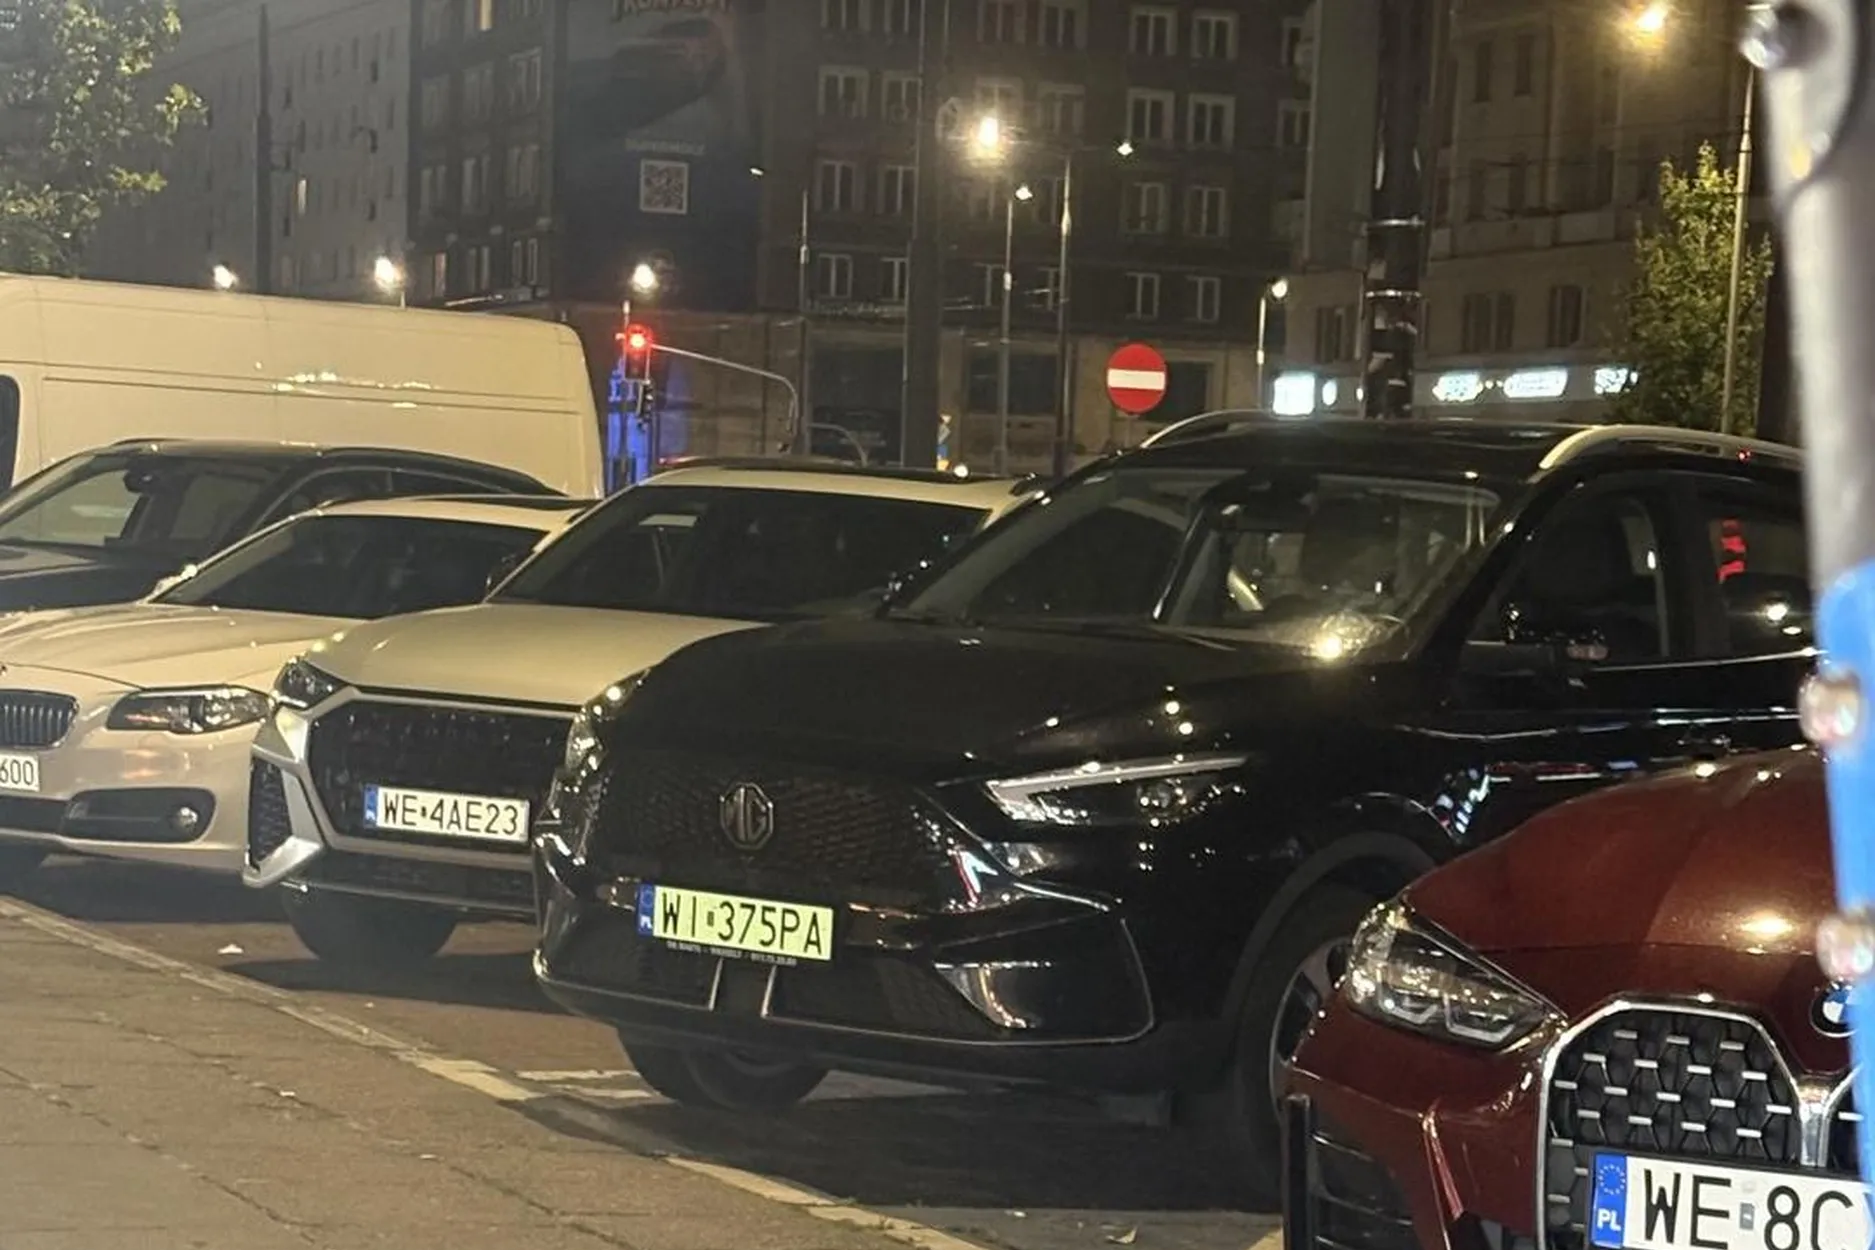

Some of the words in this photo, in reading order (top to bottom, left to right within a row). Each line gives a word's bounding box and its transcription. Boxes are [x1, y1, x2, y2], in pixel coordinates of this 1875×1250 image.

[384, 793, 418, 826] WE
[430, 798, 518, 835] 4AE23
[724, 786, 768, 843] MG
[662, 892, 697, 937] WI
[718, 901, 821, 955] 375PA
[1597, 1208, 1621, 1230] PL
[1643, 1168, 1732, 1250] WE
